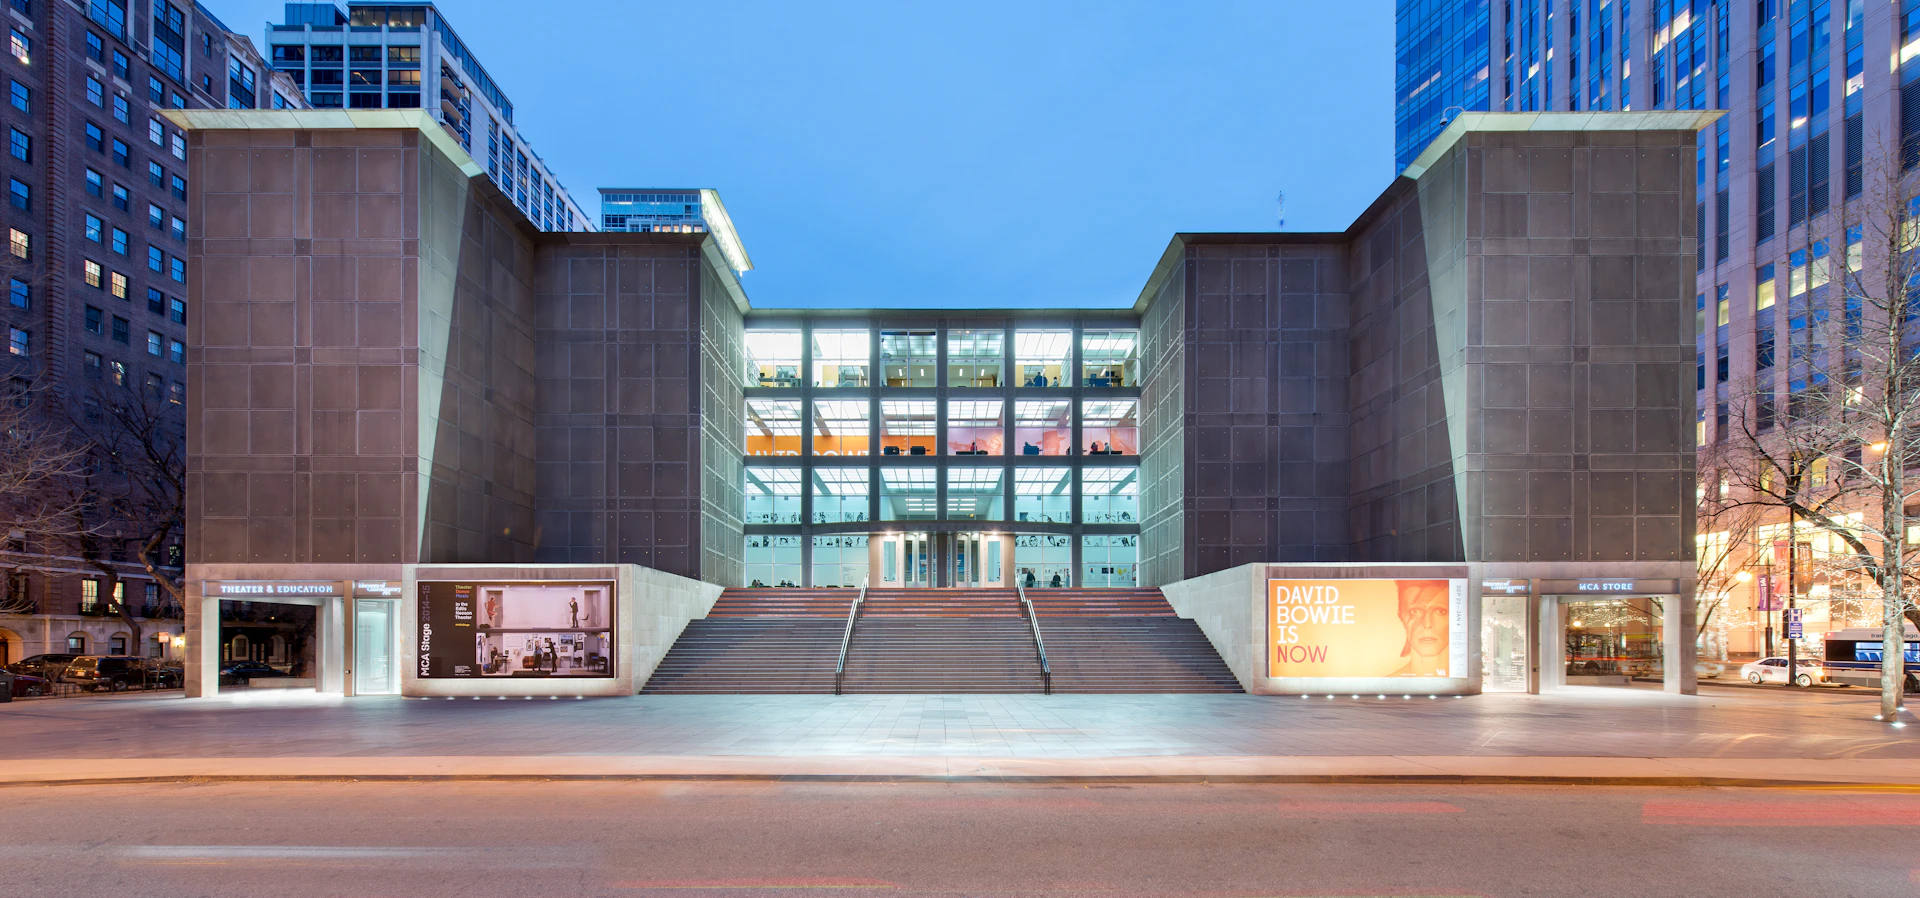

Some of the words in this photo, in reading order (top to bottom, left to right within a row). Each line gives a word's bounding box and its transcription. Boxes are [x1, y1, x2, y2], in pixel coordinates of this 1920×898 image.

[221, 585, 264, 593] THEATER
[266, 585, 274, 593] &
[277, 585, 333, 593] EDUCATION
[1277, 586, 1339, 604] DAVID
[1277, 606, 1355, 624] BOWIE
[421, 623, 432, 652] Stage
[1277, 625, 1299, 644] IS
[1277, 645, 1328, 663] NOW
[421, 653, 430, 676] MCA
